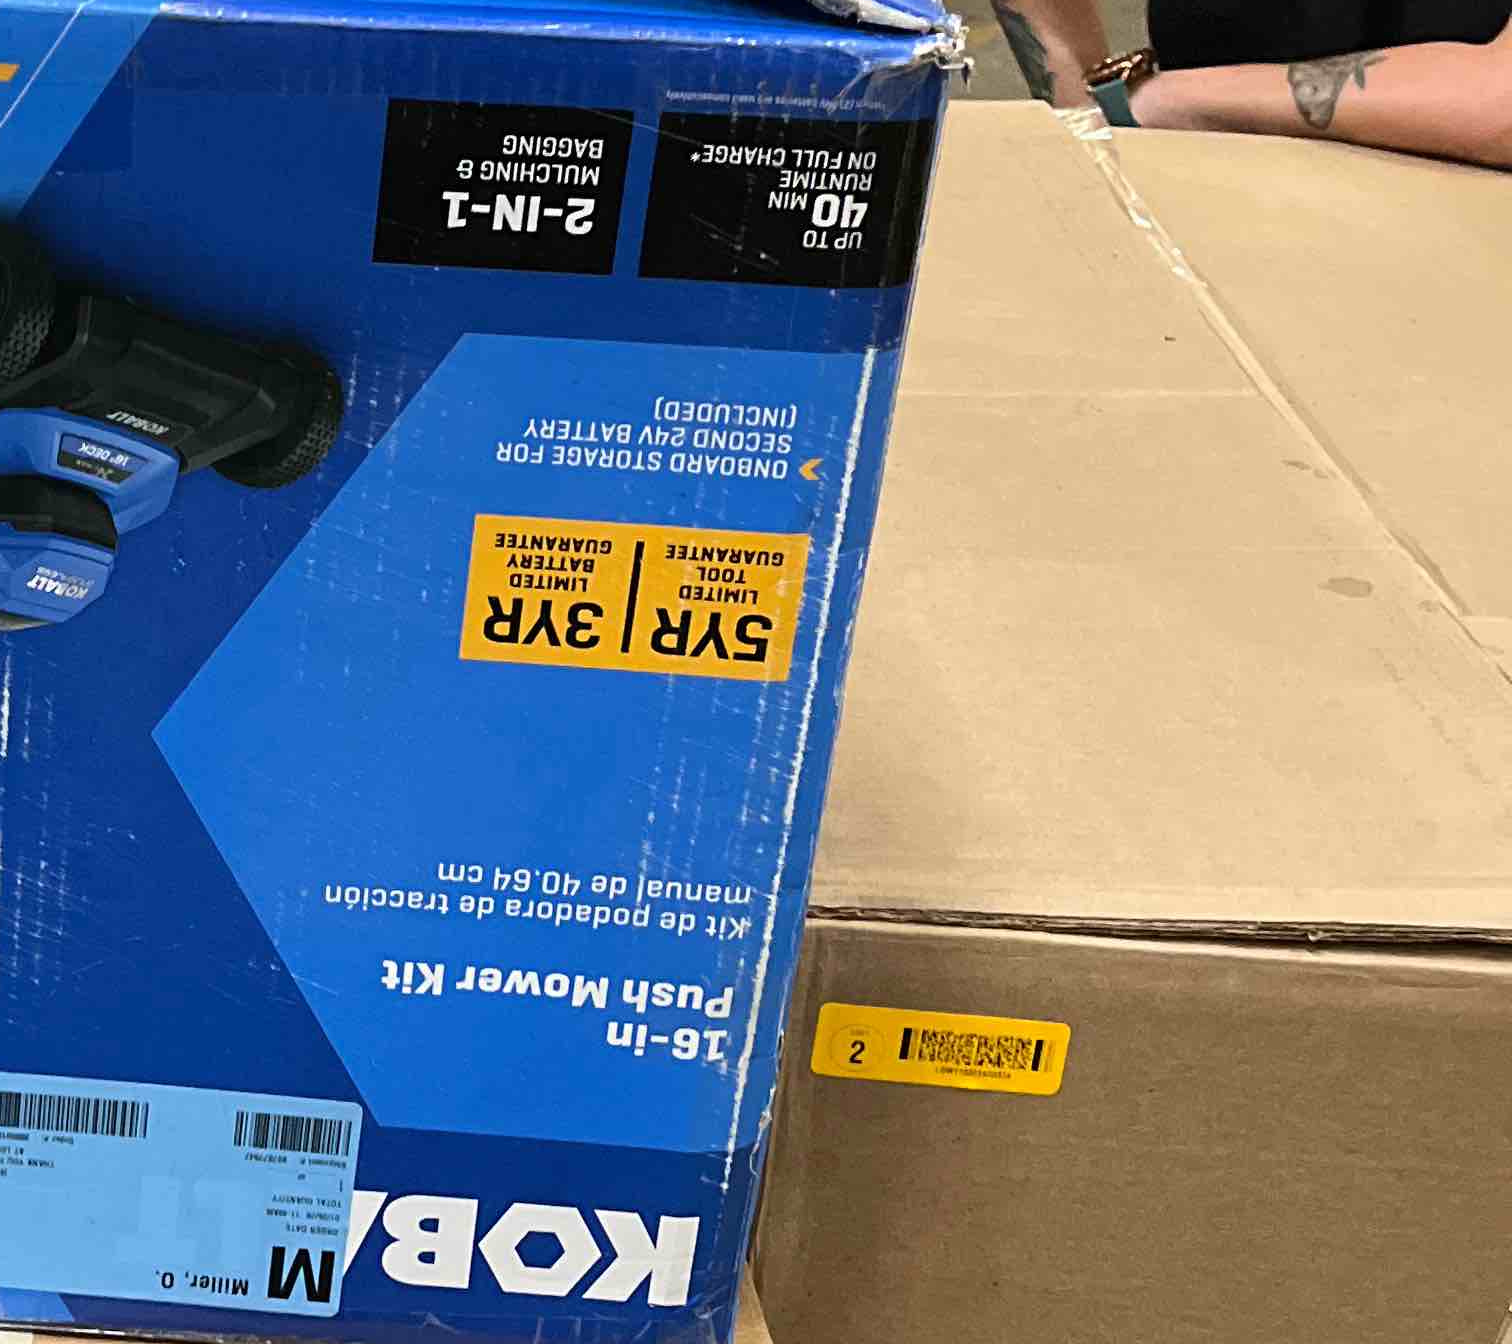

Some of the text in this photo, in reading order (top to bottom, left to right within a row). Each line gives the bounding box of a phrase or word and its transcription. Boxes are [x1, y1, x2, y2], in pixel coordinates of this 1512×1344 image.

[502, 134, 604, 159] BAGGING
[791, 148, 843, 169] FULL
[456, 159, 600, 186] MULCHING &
[848, 151, 877, 170] ON
[778, 170, 873, 191] RUNTIME
[442, 191, 595, 235] 2-IN-1
[768, 191, 869, 228] 40 MIN
[802, 230, 863, 250] UP TO
[105, 409, 170, 437] KOBALT
[653, 396, 798, 429] (INCLUDED)
[522, 418, 793, 454] SECOND 24V BATTERY
[77, 440, 111, 461] DECK
[496, 441, 789, 480] ONBOARD STORAGE FOR
[494, 532, 612, 555] GUARANTEE
[664, 544, 785, 567] GUARANTEE
[505, 553, 595, 573] BATTERY
[696, 566, 747, 584] TOOL
[26, 574, 89, 600] KOBALT
[509, 572, 588, 593] LIMITED
[678, 584, 759, 605] LIMITED
[482, 596, 604, 650] 3YR
[650, 607, 775, 663] 5YR
[436, 862, 752, 904] manual de 40.64 cm
[324, 885, 748, 940] Kit de podadora de tracción
[380, 959, 734, 1018] Push Mower Kit
[606, 1021, 729, 1062] 16-in
[849, 1040, 865, 1064] 2
[316, 1198, 342, 1208] TOTAL
[154, 1271, 249, 1297] Miller, O.
[266, 1245, 337, 1304] M
